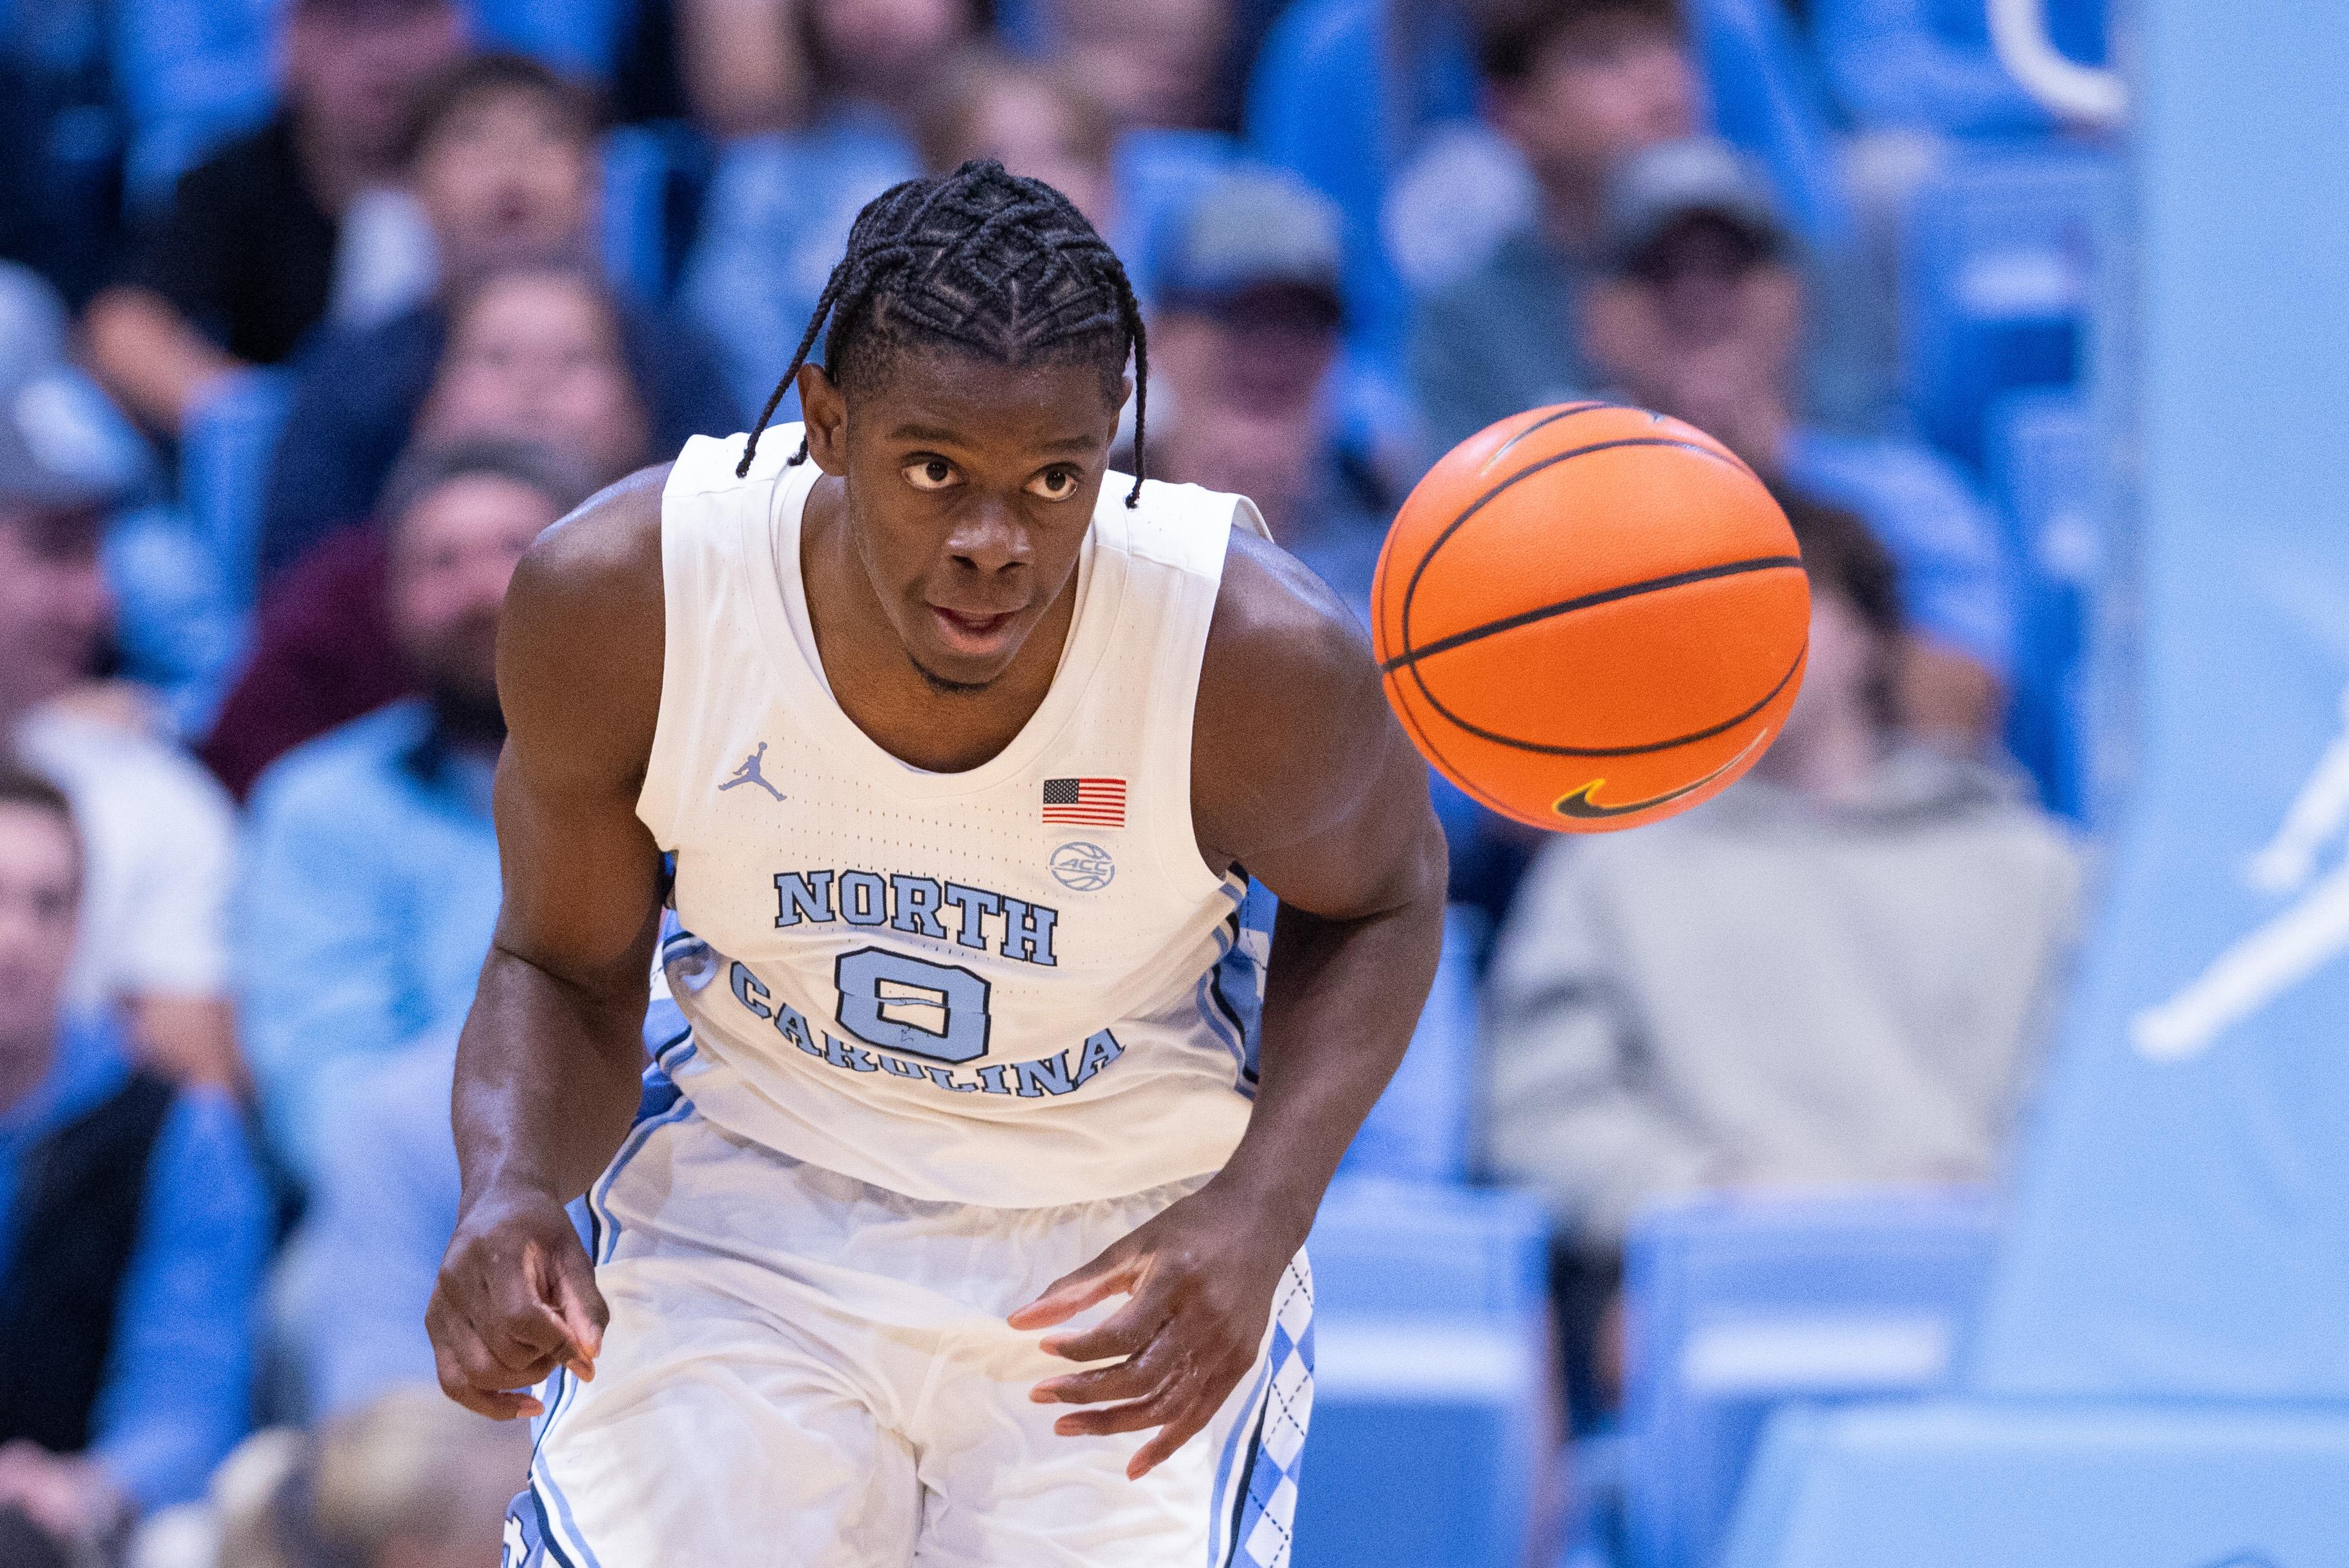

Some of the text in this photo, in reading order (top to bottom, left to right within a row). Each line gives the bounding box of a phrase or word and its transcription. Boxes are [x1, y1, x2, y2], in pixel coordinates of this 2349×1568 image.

[1059, 858, 1112, 873] ACC
[773, 869, 1059, 967] NORTH
[730, 960, 1126, 1099] CAROLINA
